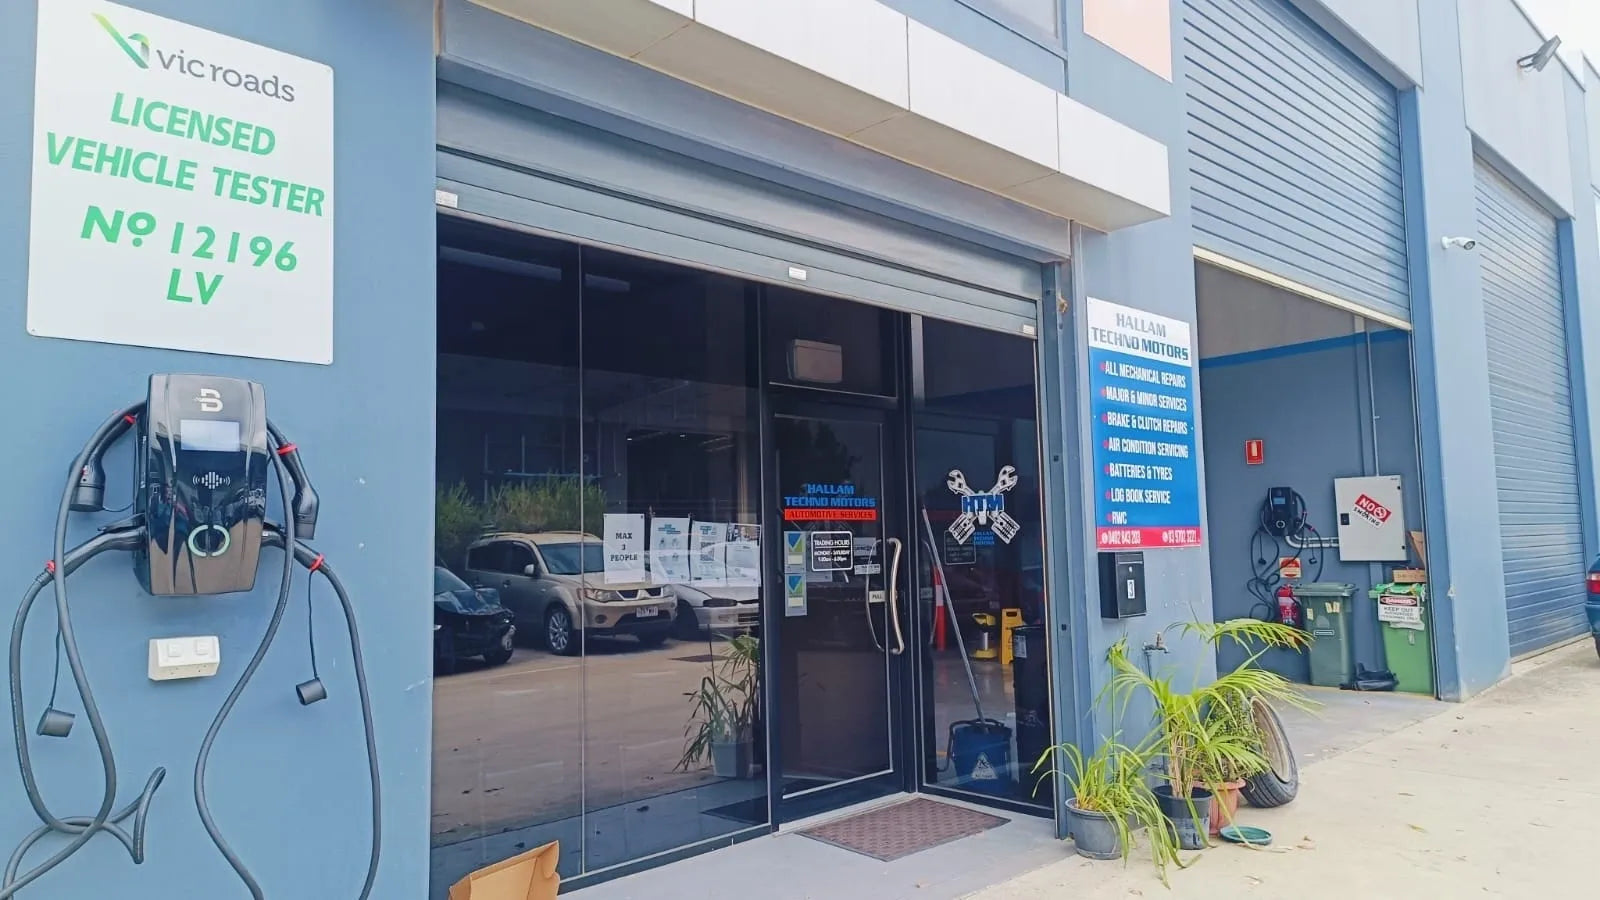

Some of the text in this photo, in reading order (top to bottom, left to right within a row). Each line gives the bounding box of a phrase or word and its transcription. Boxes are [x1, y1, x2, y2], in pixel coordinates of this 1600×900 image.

[156, 49, 295, 102] vicroads
[110, 92, 276, 156] LICENSED
[46, 131, 325, 217] VEHICLE TESTER
[170, 222, 298, 271] 12196
[166, 268, 224, 305] LV
[1115, 312, 1167, 338] HALLAM
[1090, 326, 1189, 361] TECHNO MOTORS
[1105, 360, 1187, 389] ALL MECHANICAL REPAIRS
[1106, 386, 1187, 412] MAJOR & MINOR SERVICES
[1107, 411, 1188, 435] BRAKE & CLUTCH REPAIRS
[1108, 436, 1189, 459] AIR CONDITION SERVICING
[1109, 462, 1173, 481] BATTERIES & TYRES
[807, 483, 855, 495] HALLAM
[1110, 487, 1171, 504] LOG BOOK SERVICE
[784, 496, 876, 507] TECHNO MOTORS
[962, 494, 1003, 513] HTM
[1358, 497, 1376, 512] NO
[789, 510, 873, 519] AUTOMOTIVE SERVICES
[1111, 511, 1128, 525] RWC
[1353, 506, 1381, 526] SMOKING
[615, 532, 633, 540] MAX
[610, 553, 638, 562] PEOPLE
